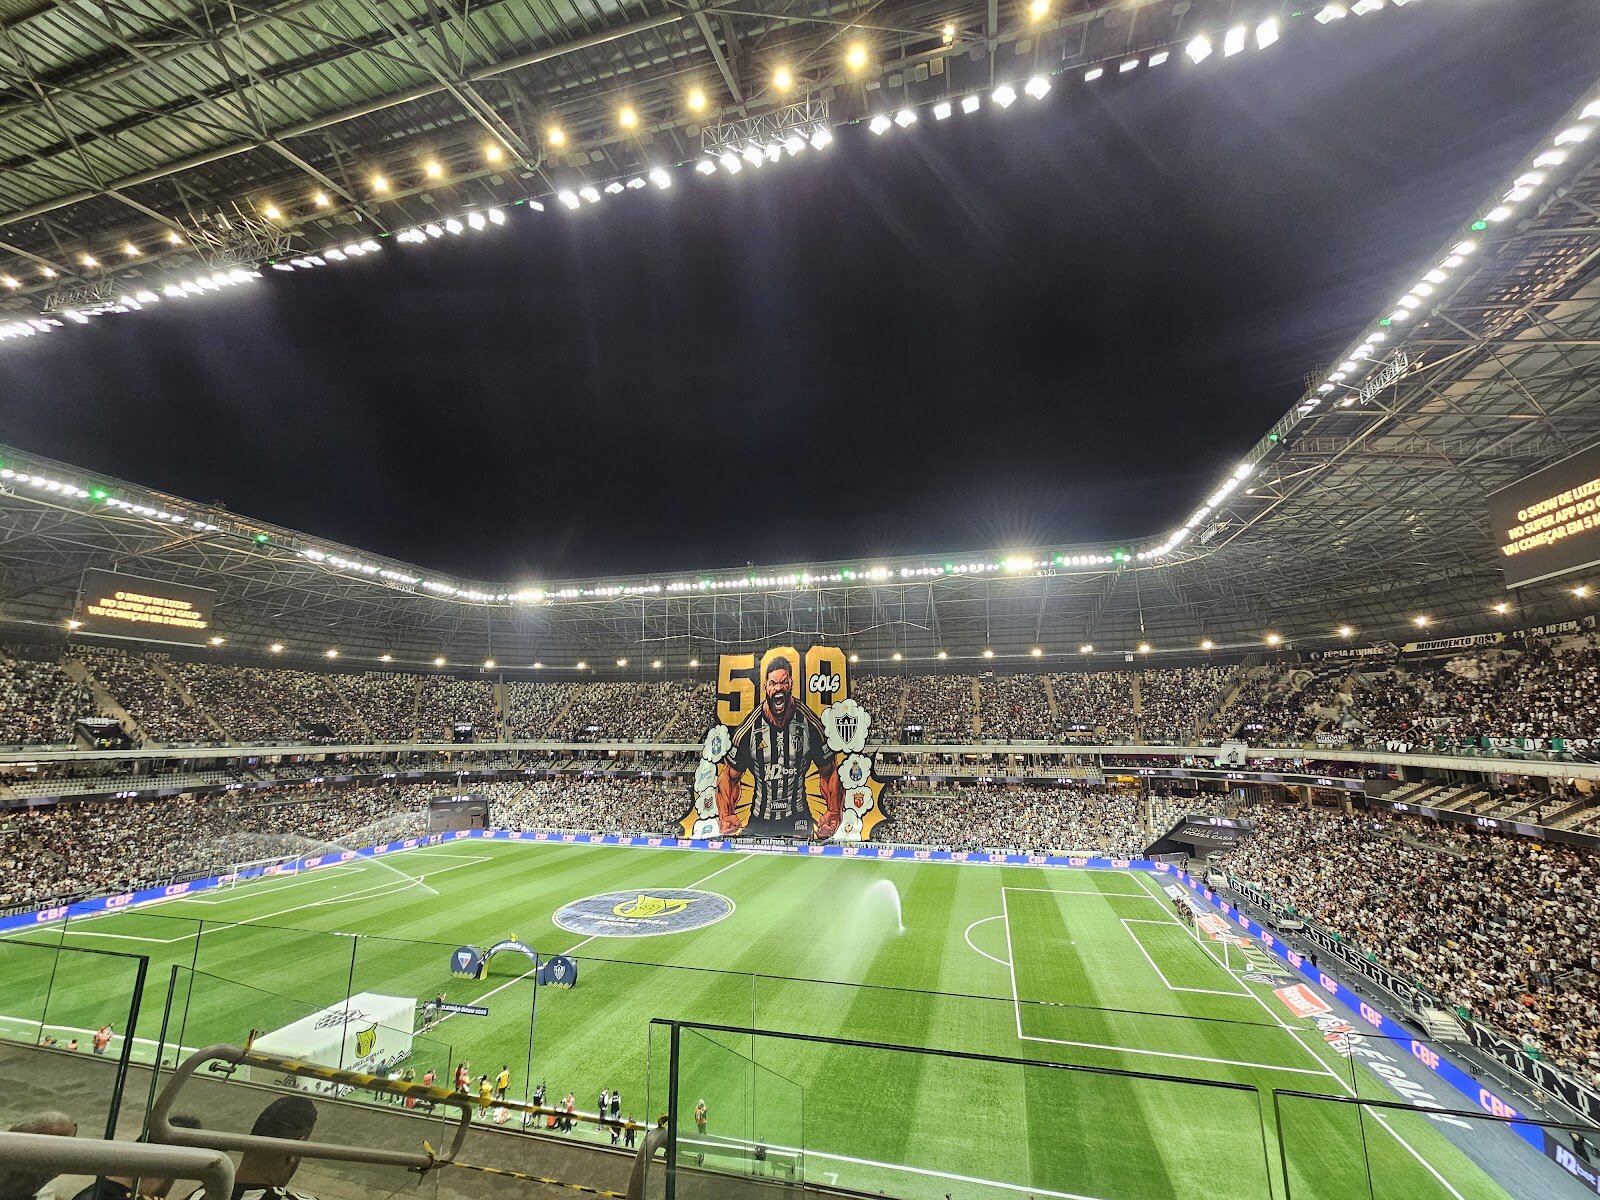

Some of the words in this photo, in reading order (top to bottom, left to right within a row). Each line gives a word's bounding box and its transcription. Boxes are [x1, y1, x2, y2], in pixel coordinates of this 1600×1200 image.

[1518, 510, 1528, 521] O
[1527, 497, 1558, 518] SHOW
[1558, 490, 1573, 506] DE
[1508, 526, 1524, 540] NO
[1524, 514, 1556, 534] SUPER
[1556, 506, 1576, 523] APP
[1576, 499, 1596, 515] DO
[1502, 544, 1520, 556] VAI
[1518, 526, 1568, 551] COMEÇAR
[1566, 519, 1584, 535] EM
[1583, 516, 1593, 528] 5
[126, 593, 153, 604] SHOW
[100, 598, 116, 608] NO
[116, 601, 145, 612] SUPER
[162, 608, 176, 616] DO
[88, 606, 106, 616] VAI
[106, 609, 150, 622] COMEÇAR
[1416, 637, 1471, 650] MOVIMENTO
[809, 674, 840, 694] GOLS
[456, 830, 471, 838] CBF
[341, 851, 357, 860] CBF
[374, 845, 388, 854] CBF
[808, 846, 824, 854] CBF
[842, 848, 859, 856] CBF
[878, 849, 894, 857] CBF
[914, 850, 930, 858] CBF
[951, 852, 968, 860] CBF
[305, 858, 322, 868] CBF
[989, 854, 1008, 862] CBF
[1028, 856, 1046, 864] CBF
[1069, 858, 1088, 866] CBF
[1111, 860, 1130, 868] CBF
[1154, 862, 1170, 872] CBF
[165, 882, 192, 896] CBF
[106, 893, 134, 908] CBF
[36, 906, 70, 922] CBF
[1220, 901, 1230, 914] CBF
[1239, 914, 1250, 927] CBF
[1262, 930, 1274, 946] CBF
[1288, 950, 1302, 968] CBF
[1320, 973, 1338, 995] CBF
[1360, 1002, 1383, 1028] CBF
[1410, 1039, 1440, 1070] CBF
[1479, 1088, 1517, 1126] CBF
